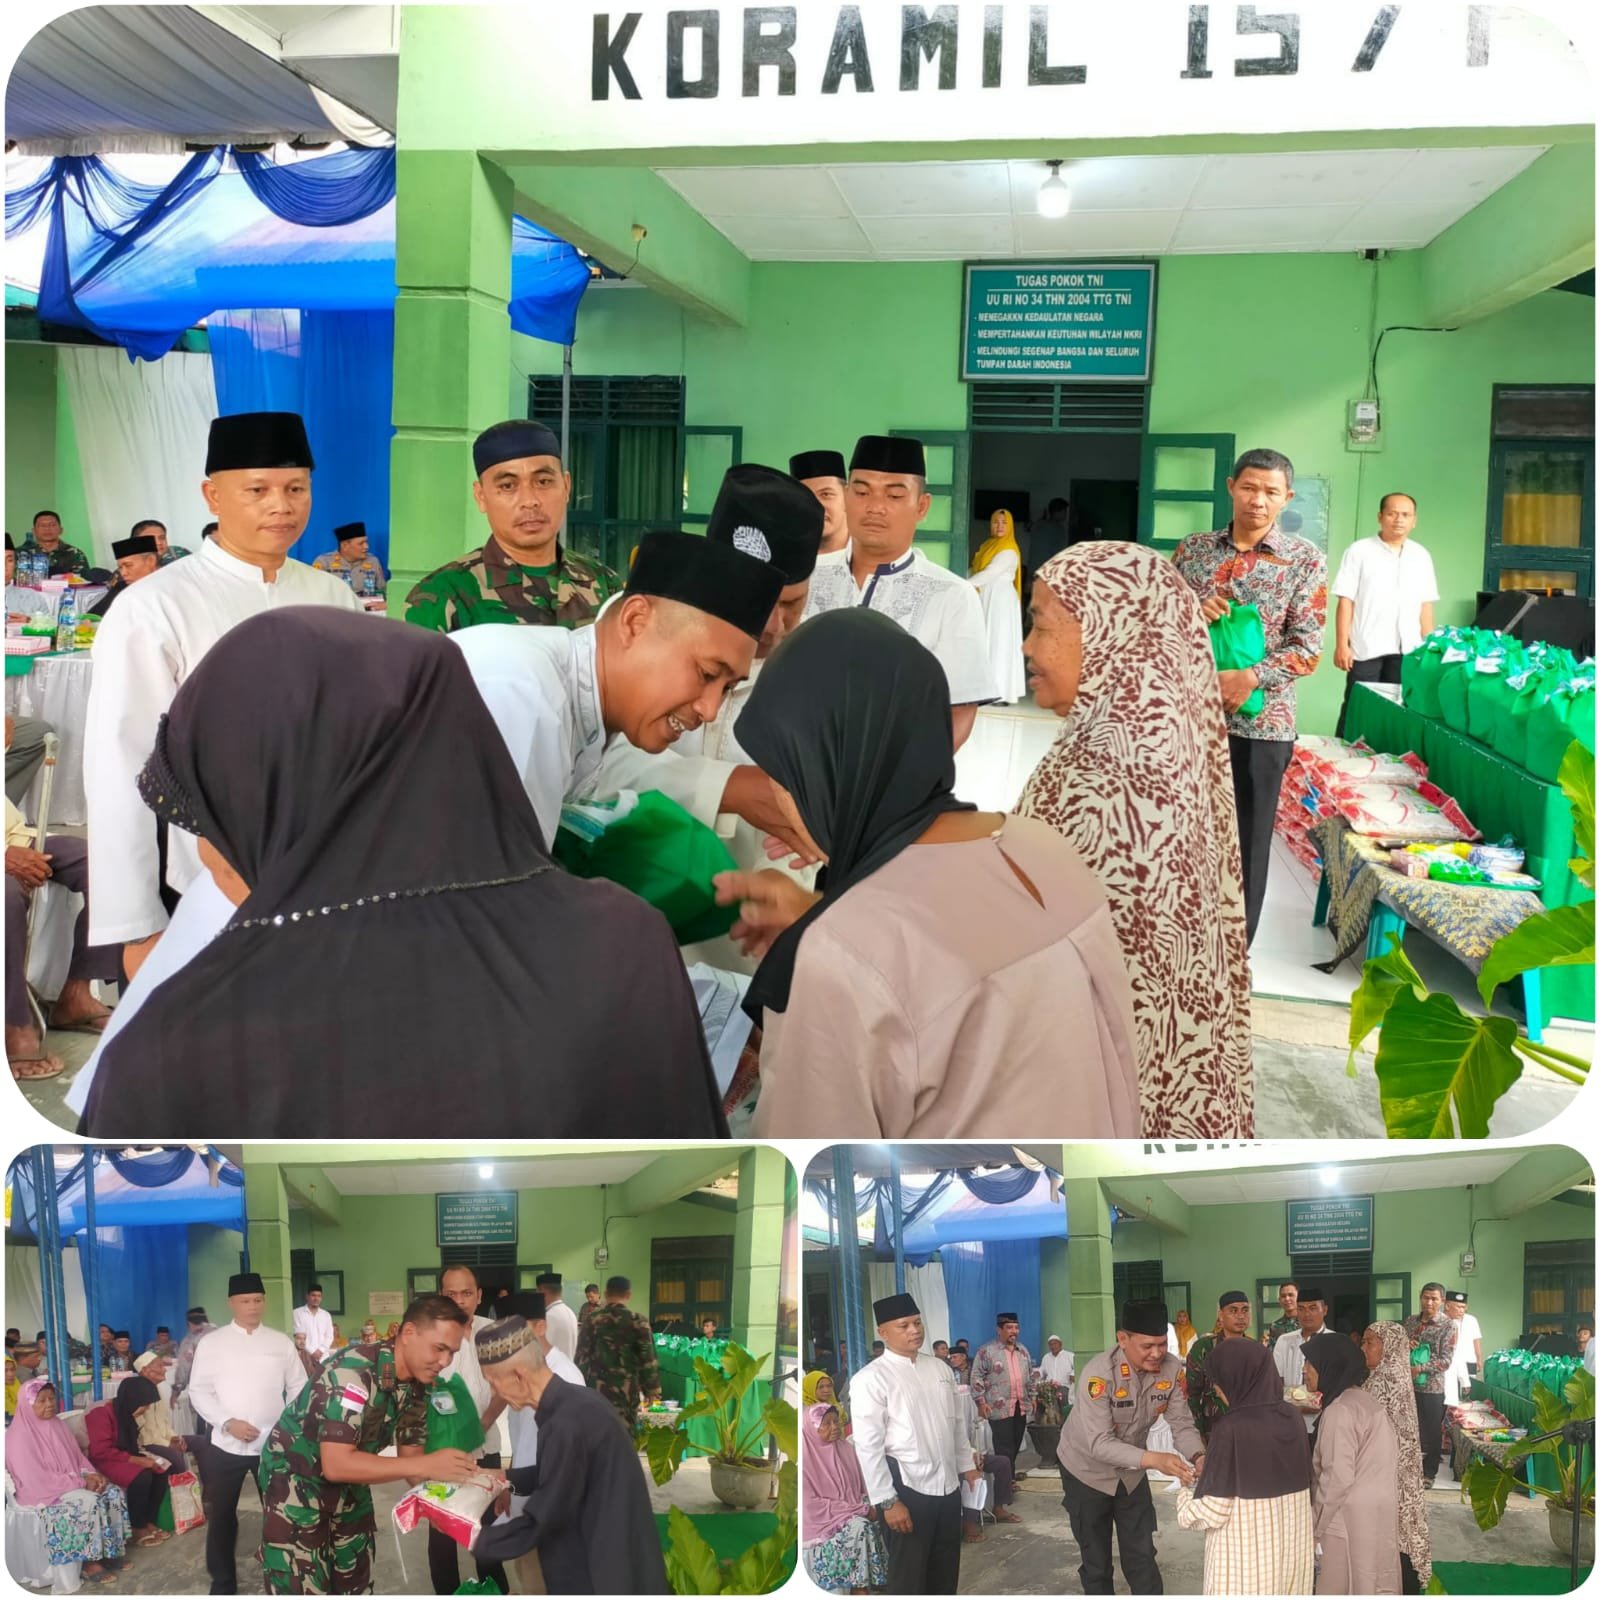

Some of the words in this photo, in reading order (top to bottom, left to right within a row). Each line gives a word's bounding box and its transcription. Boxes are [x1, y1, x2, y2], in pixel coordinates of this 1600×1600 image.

[591, 5, 1088, 100] KORAMIL
[1180, 5, 1300, 78] 15
[1015, 275, 1048, 287] TUGAS
[1050, 274, 1085, 287] POKOK
[1086, 274, 1104, 287] TNI
[986, 293, 1000, 306] UU
[1002, 293, 1012, 305] RI
[1014, 293, 1029, 305] NO
[1031, 293, 1043, 305] 34
[1045, 293, 1065, 305] THN
[1067, 293, 1090, 305] 2004
[1093, 293, 1112, 305] TTG
[1115, 293, 1132, 305] TNI
[1024, 312, 1072, 321] KEDAULATAN
[1073, 312, 1104, 321] NEGARA
[977, 329, 1046, 339] MEMPERTAHANKAN
[1047, 329, 1087, 339] KEUTUHAN
[1089, 329, 1122, 339] WILAYAH
[1123, 329, 1143, 339] NKRI
[977, 346, 1021, 356] MELINDUNGI
[1022, 346, 1055, 356] SEGENAP
[1056, 346, 1086, 356] BANGSA
[1087, 347, 1103, 356] DAN
[1105, 347, 1140, 357] SELURUH
[976, 359, 1006, 369] TUMPAH
[1007, 359, 1032, 369] DARAH
[1033, 359, 1072, 369] INDONESIA
